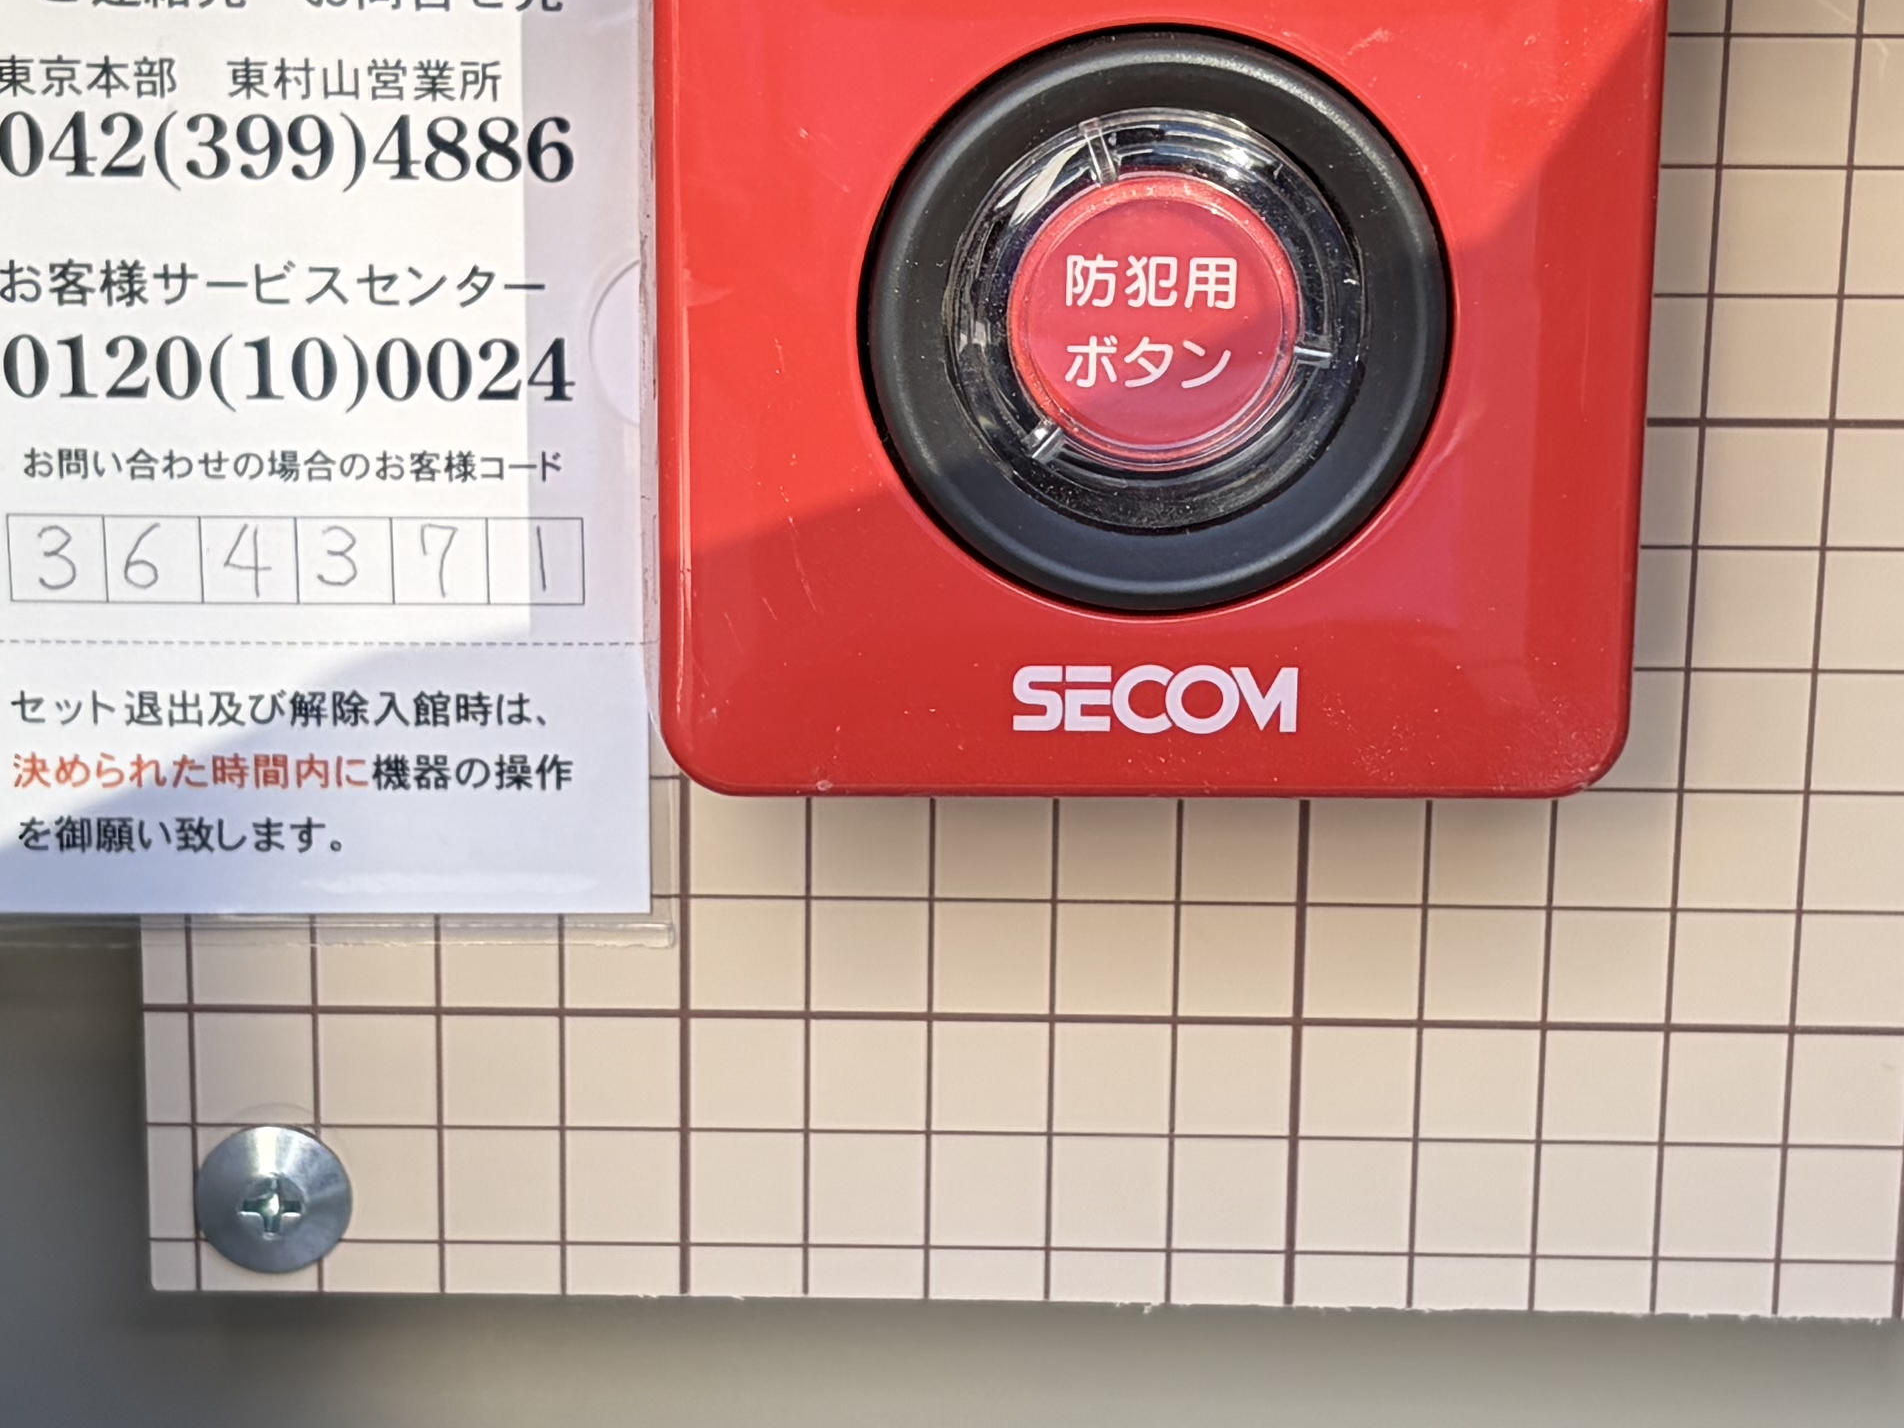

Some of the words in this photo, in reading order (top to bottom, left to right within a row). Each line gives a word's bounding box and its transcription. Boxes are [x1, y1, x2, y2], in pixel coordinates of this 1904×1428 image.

[226, 58, 502, 103] 東村山営業所
[1063, 253, 1239, 310] 防犯用
[2, 332, 576, 413] 0120(10)0024
[1063, 335, 1232, 390] ボタン
[23, 447, 563, 484] お問い合わせの場合のお客様コード
[10, 690, 549, 729] セット退出及び解除入館時は、
[1011, 664, 1300, 736] SECOM
[12, 753, 574, 793] 決められた時間内に機器の操作
[18, 815, 345, 854] を御願い致します。
